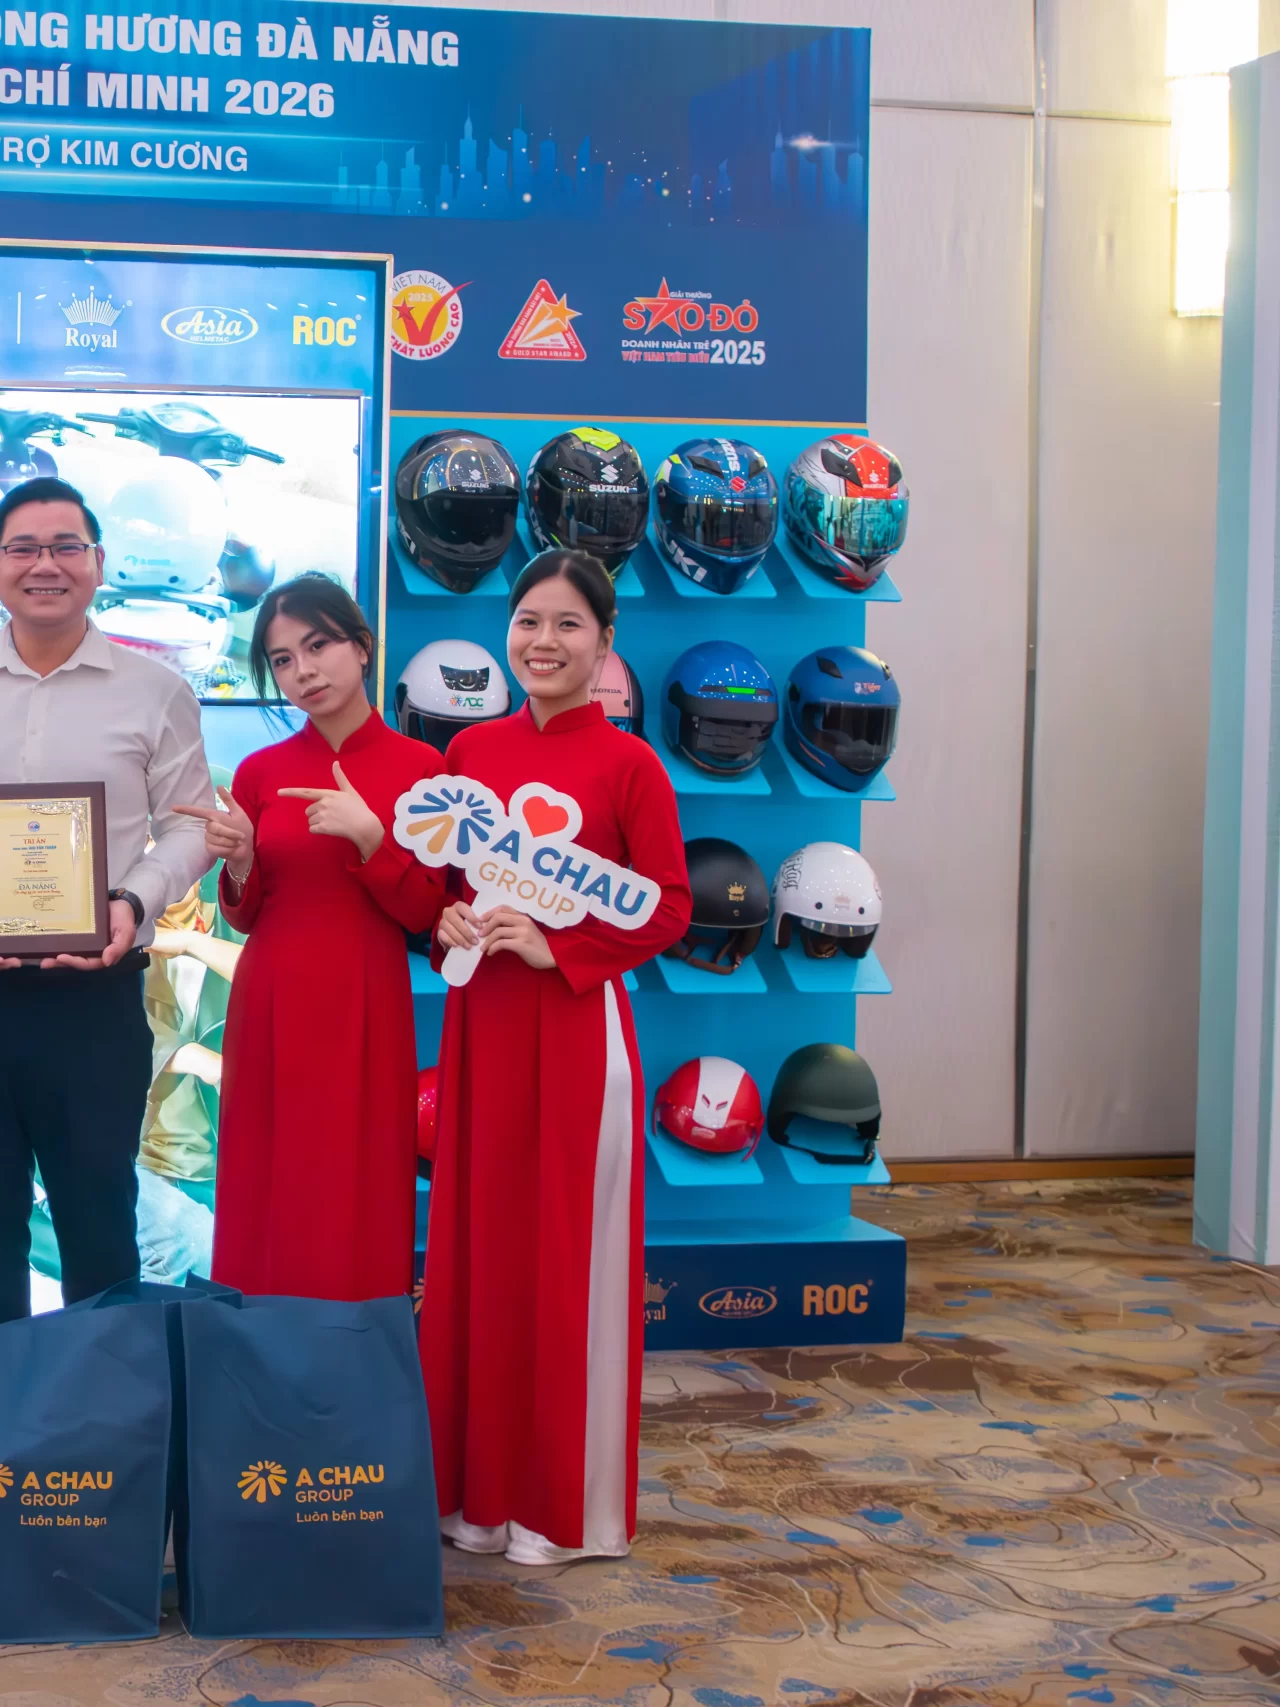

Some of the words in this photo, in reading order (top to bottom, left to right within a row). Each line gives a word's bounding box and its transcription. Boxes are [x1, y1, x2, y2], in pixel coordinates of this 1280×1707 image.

[85, 13, 242, 57] HƯƠNG
[256, 16, 319, 60] ĐÀ
[333, 14, 460, 67] NẴNG
[87, 72, 209, 113] MINH
[224, 79, 336, 118] 2026
[61, 139, 119, 166] KIM
[130, 141, 248, 172] CƯƠNG
[418, 274, 447, 294] NAM
[175, 310, 244, 337] Asia
[450, 302, 460, 327] CAO
[706, 299, 759, 333] ĐỎ
[64, 328, 117, 353] Royal
[293, 315, 357, 347] ROC
[621, 339, 660, 348] DOANH
[661, 339, 691, 349] NHÂN
[710, 339, 766, 366] 2025
[589, 484, 630, 493] SUZUKI
[489, 829, 521, 864] A
[531, 846, 648, 916] CHAU
[478, 860, 575, 916] GROUP
[709, 1289, 765, 1312] Asia
[802, 1283, 869, 1316] ROC
[643, 1305, 667, 1324] yal
[21, 1471, 41, 1490] A
[45, 1471, 113, 1490] CHAU
[295, 1468, 314, 1487] A
[318, 1464, 385, 1486] CHAU
[20, 1493, 80, 1507] GROUP
[295, 1488, 354, 1503] GROUP
[20, 1514, 53, 1527] Luôn
[56, 1514, 81, 1527] bên
[84, 1514, 107, 1528] bạn
[296, 1511, 329, 1523] Luôn
[332, 1510, 356, 1522] bên
[360, 1509, 384, 1522] bạn
